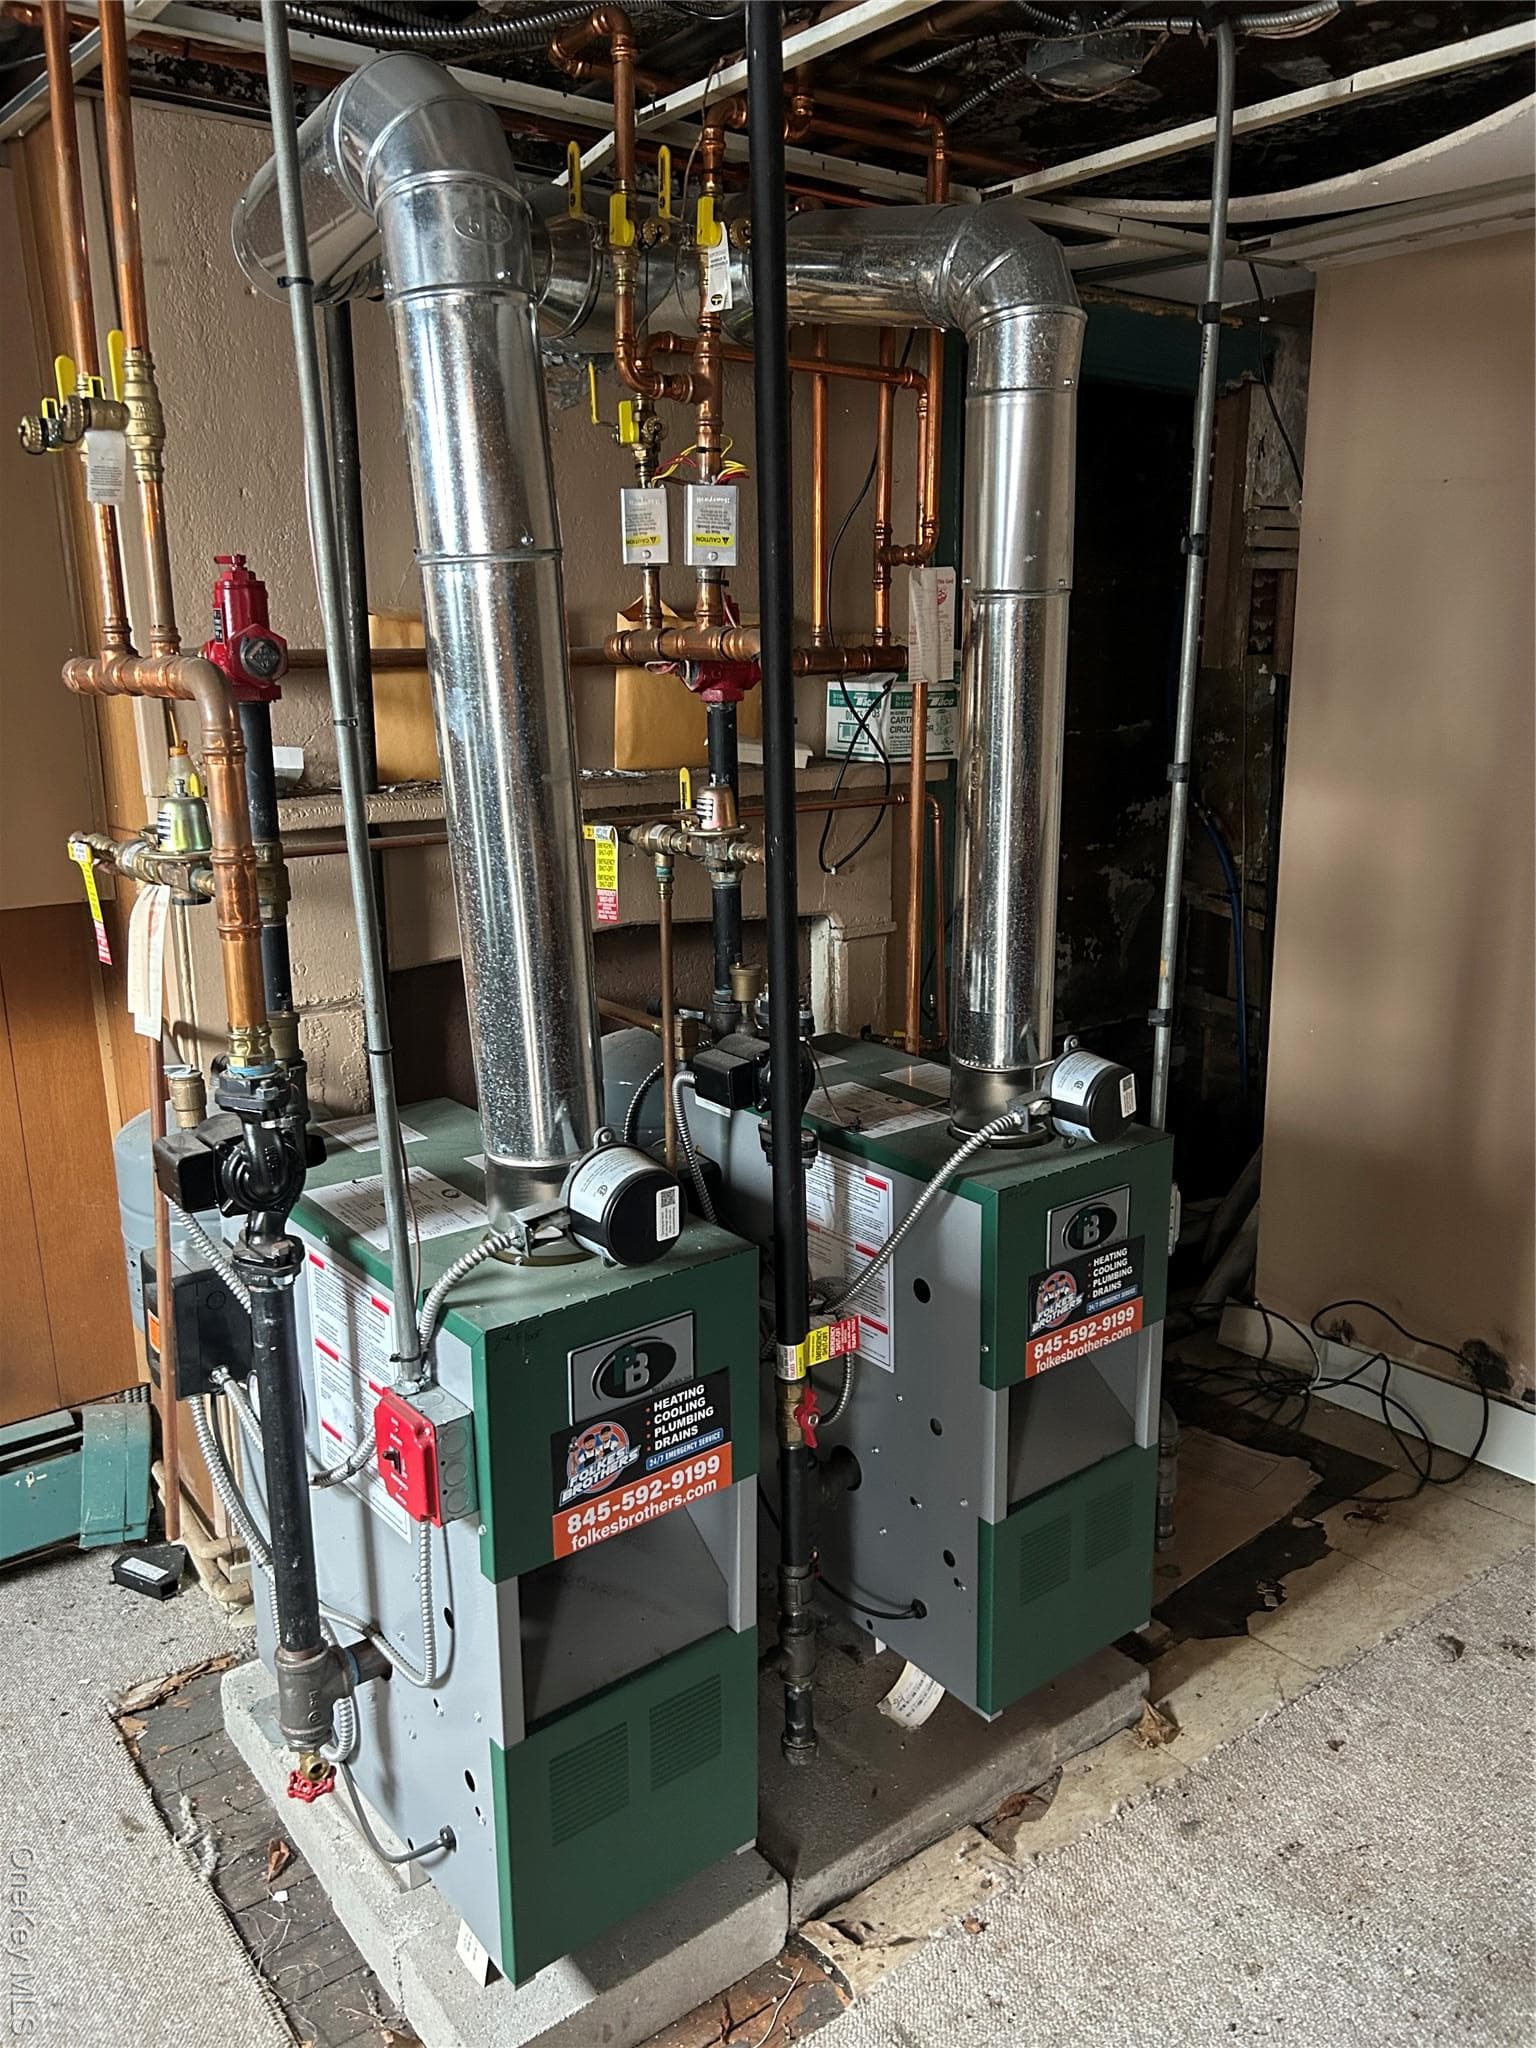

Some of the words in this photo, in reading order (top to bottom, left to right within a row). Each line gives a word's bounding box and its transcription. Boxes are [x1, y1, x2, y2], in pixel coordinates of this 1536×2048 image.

[696, 536, 721, 544] CAUTION
[1092, 1257, 1128, 1277] COOLING
[1093, 1247, 1128, 1267] HEATING
[1092, 1266, 1133, 1288] PLUMBING
[1092, 1280, 1122, 1298] DRAINS
[1031, 1295, 1082, 1332] BROTHERS
[1037, 1293, 1075, 1321] FOLKES
[1034, 1306, 1135, 1359] 845-592-9199
[1036, 1326, 1132, 1373] folkesbrothers.com
[653, 1384, 705, 1412] HEATING
[653, 1397, 706, 1425] COOLING
[654, 1406, 714, 1438] PLUMBING
[649, 1454, 664, 1467] 24/7
[665, 1441, 697, 1460] EMERGENCY
[698, 1431, 721, 1446] SERVICE
[654, 1425, 699, 1451] DRAINS
[562, 1449, 639, 1502] BROTHERS
[570, 1448, 626, 1488] FOLKES
[567, 1454, 721, 1535] 845-592-9199
[571, 1479, 718, 1551] folkesbrothers.com
